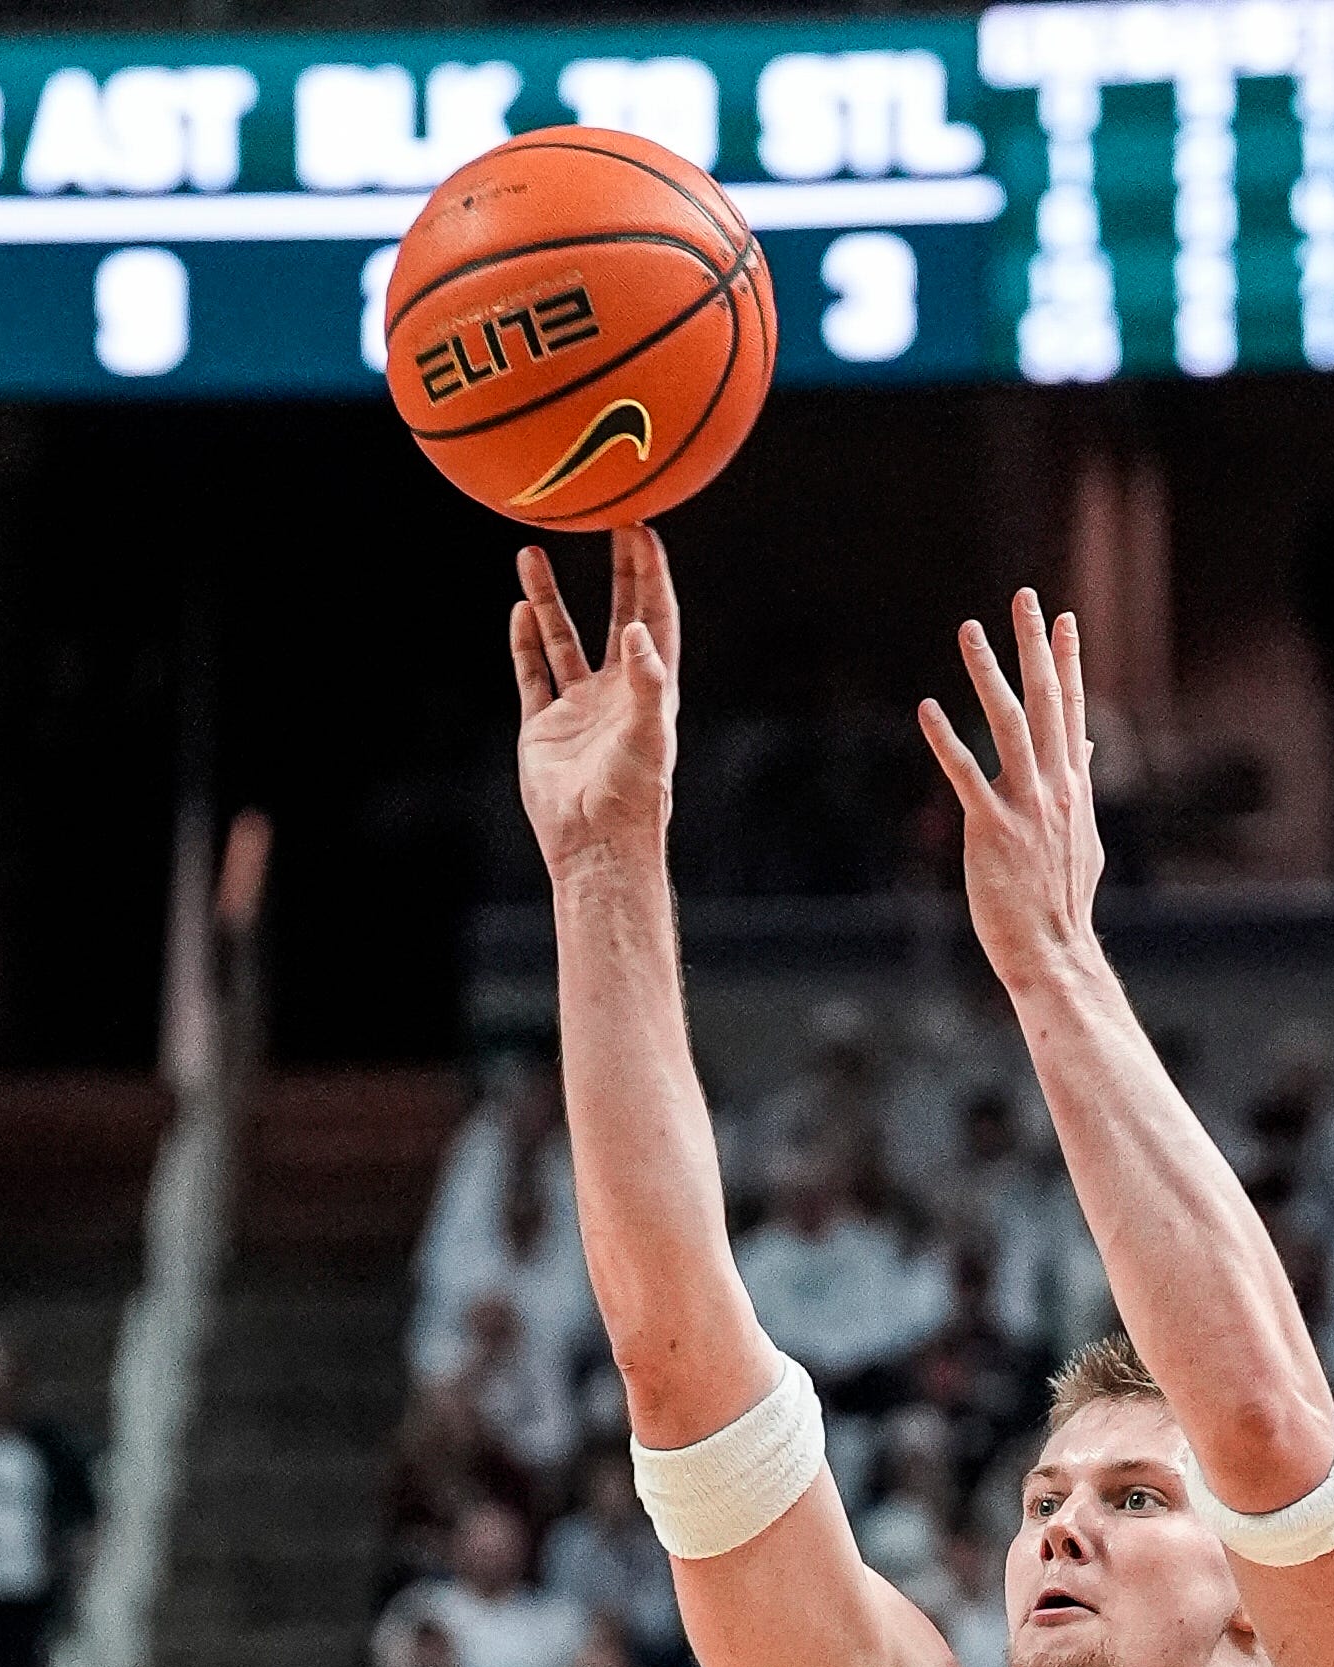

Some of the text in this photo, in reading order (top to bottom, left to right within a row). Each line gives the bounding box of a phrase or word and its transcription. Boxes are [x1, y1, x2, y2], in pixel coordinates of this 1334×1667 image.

[24, 66, 257, 194] AST
[758, 52, 983, 180] STL
[415, 284, 601, 407] ELITE
[823, 233, 916, 361] 3
